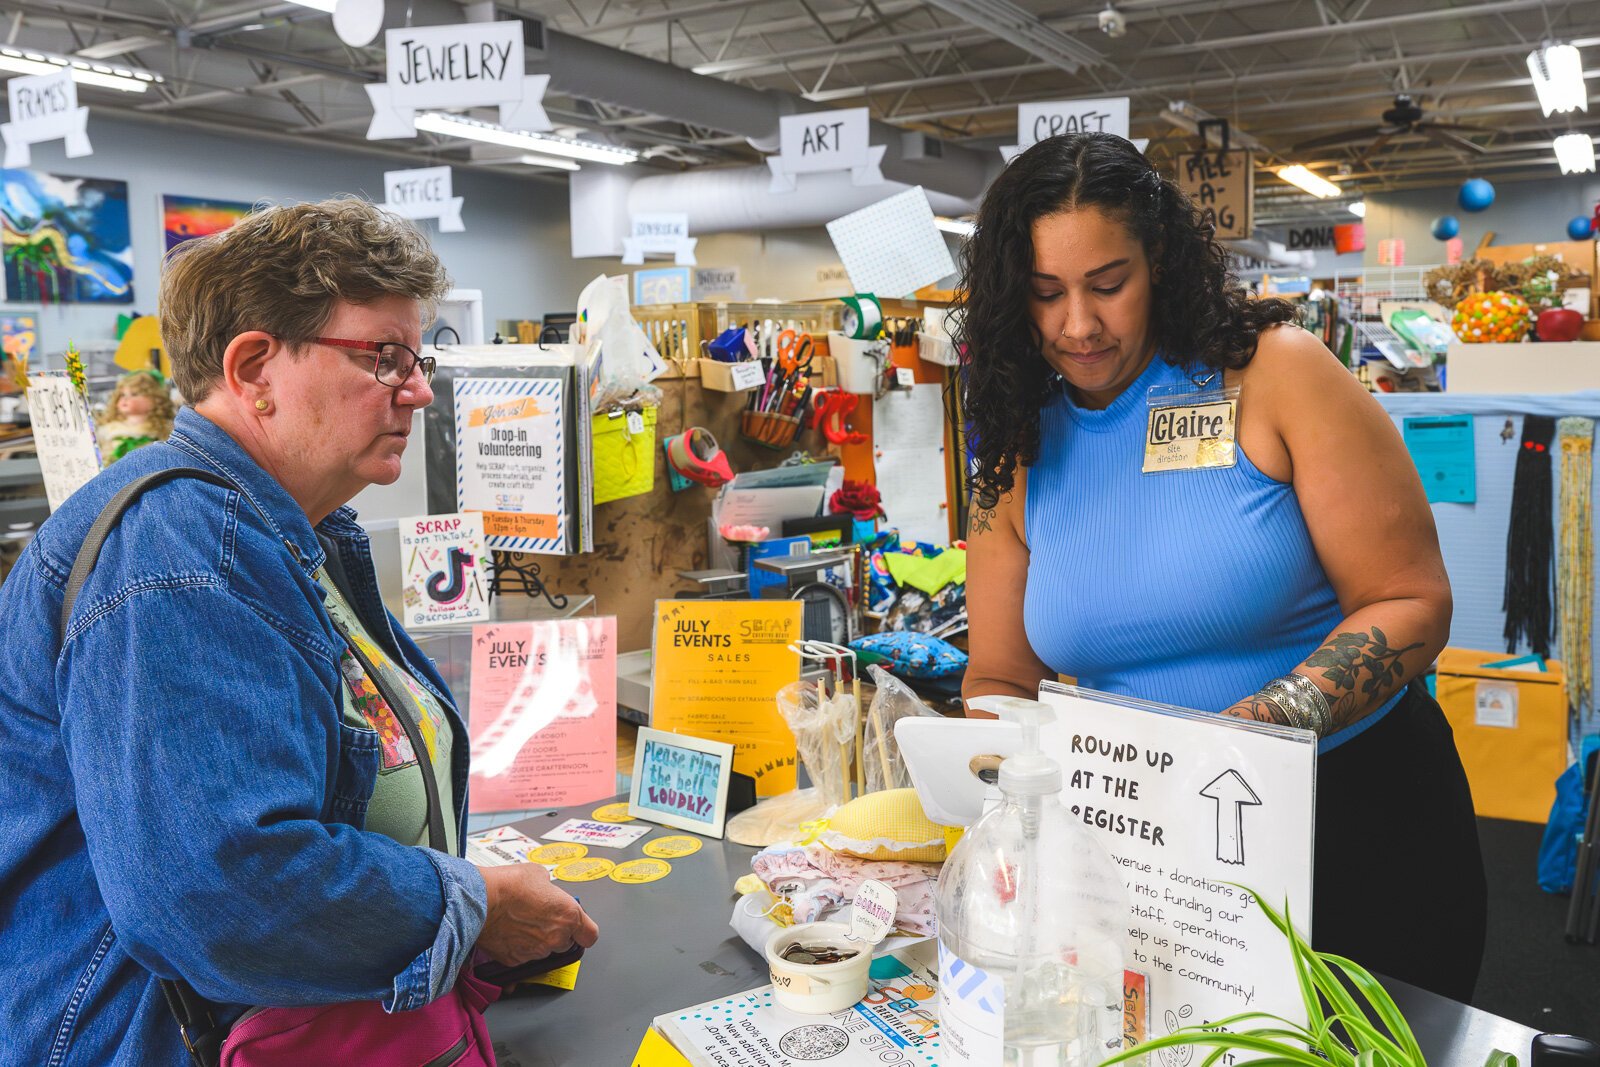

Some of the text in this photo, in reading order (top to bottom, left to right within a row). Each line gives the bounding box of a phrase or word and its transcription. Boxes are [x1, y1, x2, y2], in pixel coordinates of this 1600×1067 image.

[400, 40, 512, 84] JEWELRY
[17, 81, 67, 120] FRAMES
[802, 122, 844, 156] ART
[1034, 111, 1111, 142] CRAFT
[391, 177, 443, 203] OFFICE
[483, 400, 527, 424] Join us!
[1154, 410, 1223, 441] Claire
[478, 442, 542, 459] Volunteering
[491, 428, 527, 444] Drop-in
[1157, 453, 1189, 463] director
[403, 536, 411, 545] is
[416, 518, 461, 535] SCRAP
[429, 604, 455, 613] follow
[673, 620, 710, 633] JULY
[673, 634, 731, 648] EVENTS
[489, 641, 526, 655] JULY
[489, 653, 547, 668] EVENS
[708, 654, 750, 662] SALES
[1071, 734, 1174, 773] ROUND UP
[649, 764, 705, 795] the bell
[1071, 770, 1139, 800] AT THE
[648, 786, 713, 816] LOUDLY!
[576, 823, 621, 832] SCRAP
[1136, 881, 1243, 924] into funding our
[1170, 868, 1233, 897] donations
[1240, 892, 1257, 909] go
[1173, 918, 1248, 952] operations,
[1153, 936, 1168, 948] us
[1174, 941, 1224, 967] provide
[1133, 949, 1255, 1006] to the community!
[724, 1023, 742, 1038] New
[830, 1008, 869, 1033] NE
[873, 1005, 906, 1029] CREATIVE
[901, 1029, 927, 1045] REUSE
[709, 1026, 730, 1046] Order
[727, 1047, 741, 1057] for
[739, 1019, 761, 1037] 100%
[757, 1038, 781, 1059] Reuse
